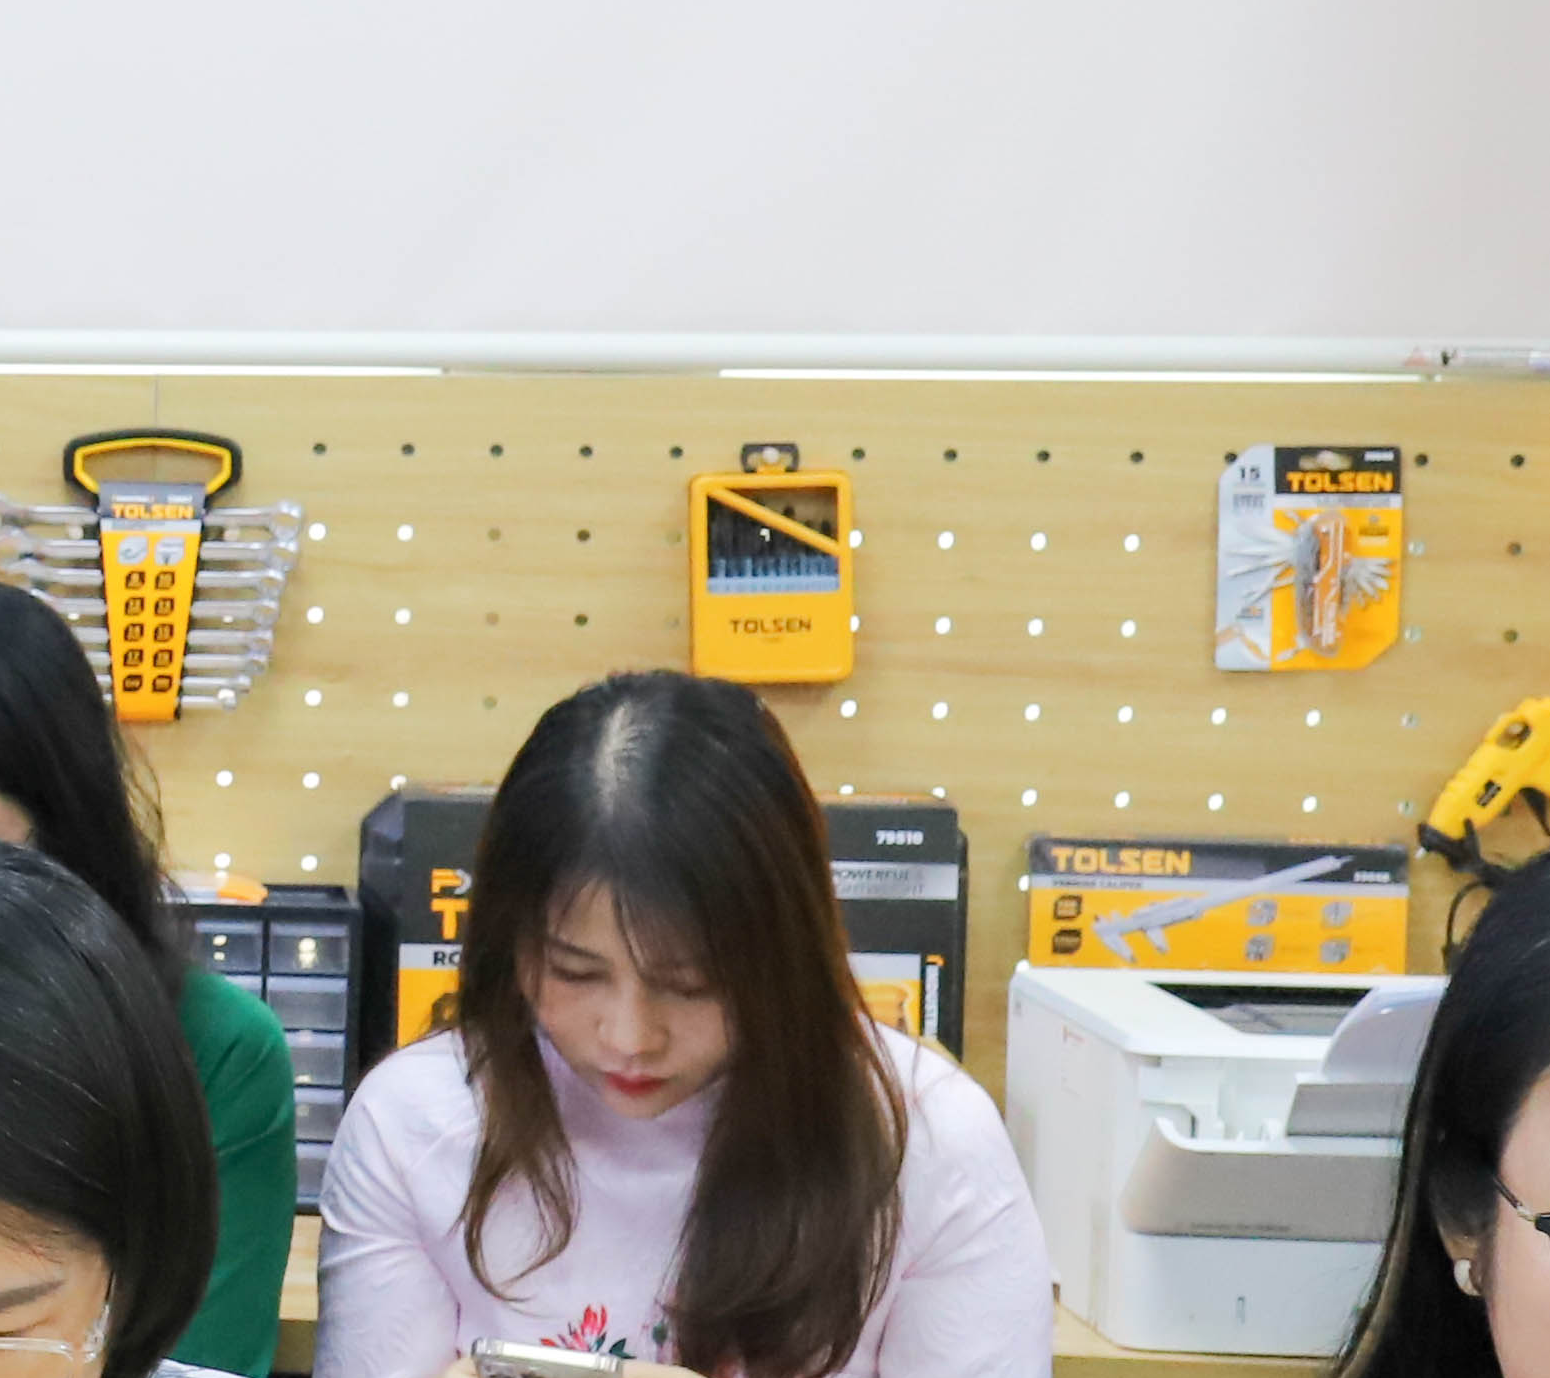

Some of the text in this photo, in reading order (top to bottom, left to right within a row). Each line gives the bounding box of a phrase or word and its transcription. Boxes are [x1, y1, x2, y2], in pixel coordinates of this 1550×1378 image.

[1240, 466, 1261, 481] 15
[1287, 471, 1395, 492] TOLSEN
[111, 502, 195, 520] TOLSEN
[730, 616, 812, 634] TOLSEN
[1051, 845, 1192, 877] TOLSEN
